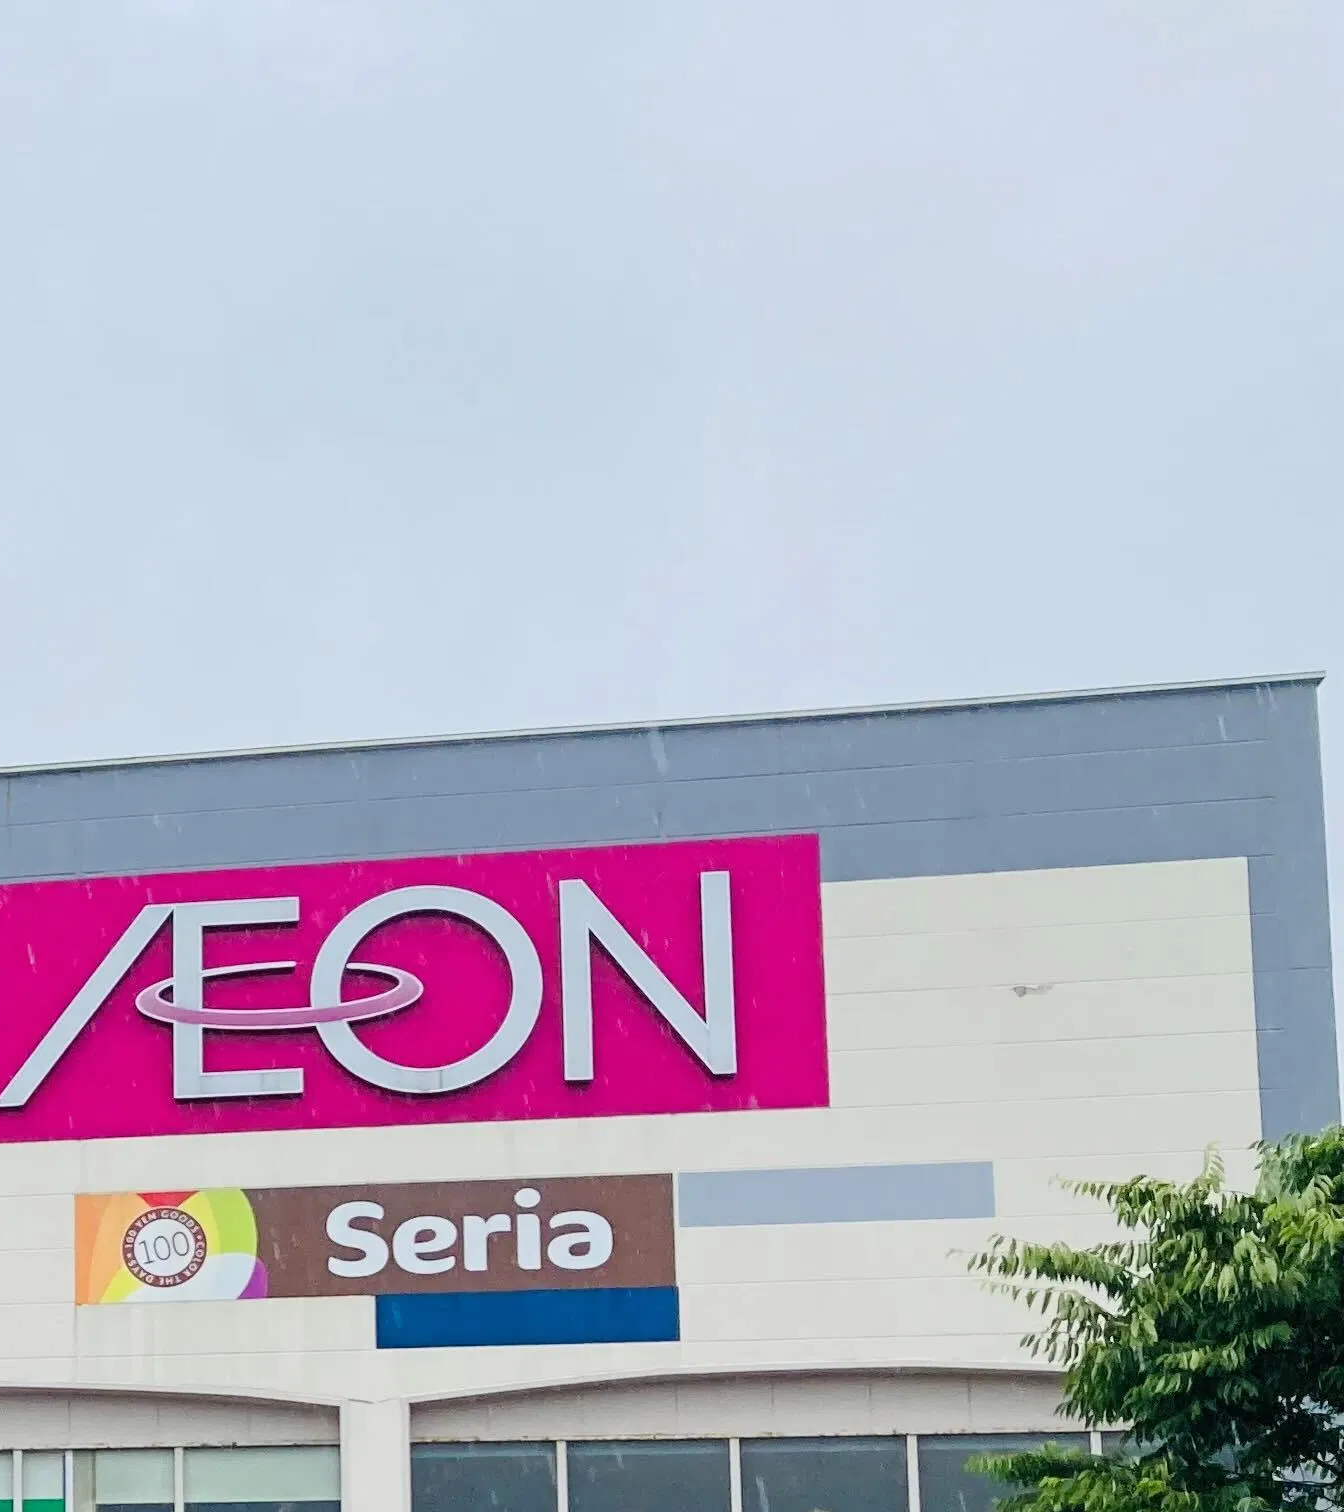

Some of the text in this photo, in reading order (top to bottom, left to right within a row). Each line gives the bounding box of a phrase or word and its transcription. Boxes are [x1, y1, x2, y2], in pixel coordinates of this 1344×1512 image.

[134, 1211, 158, 1229] YEN
[160, 1209, 199, 1235] GOODS
[183, 1242, 206, 1277] COLOR
[138, 1230, 190, 1265] 100
[325, 1187, 614, 1279] Seria
